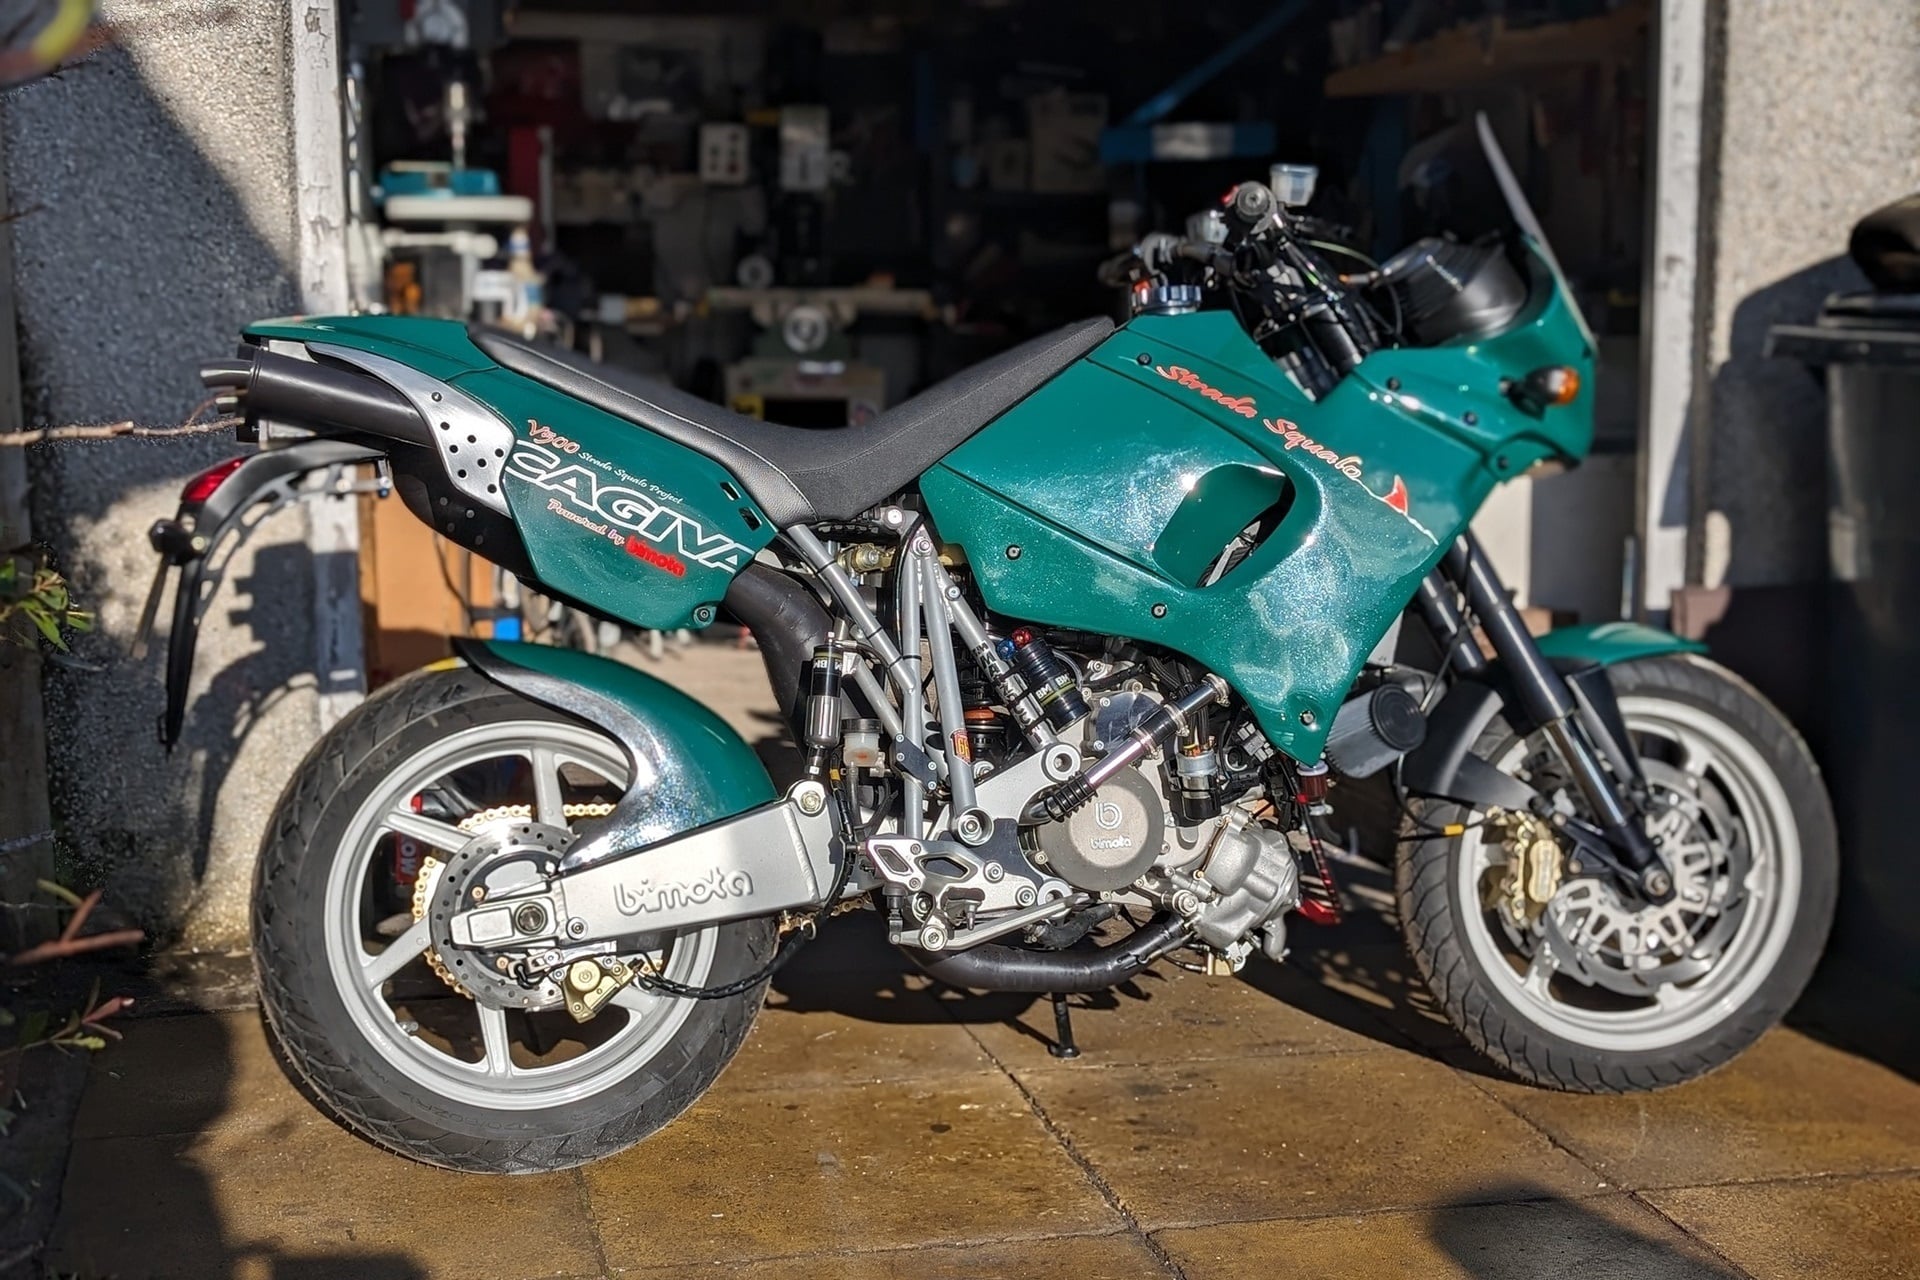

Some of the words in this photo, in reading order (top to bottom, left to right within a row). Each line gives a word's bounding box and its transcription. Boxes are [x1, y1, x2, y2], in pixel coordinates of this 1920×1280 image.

[1156, 365, 1258, 419] Strada
[1262, 418, 1363, 480] Squalo
[578, 452, 613, 472] Strada
[614, 469, 648, 489] Squalo
[649, 484, 684, 504] Project
[505, 440, 755, 574] CAGIVA
[547, 497, 609, 536] Powered
[1090, 834, 1132, 850] bimota
[612, 865, 754, 917] bimota
